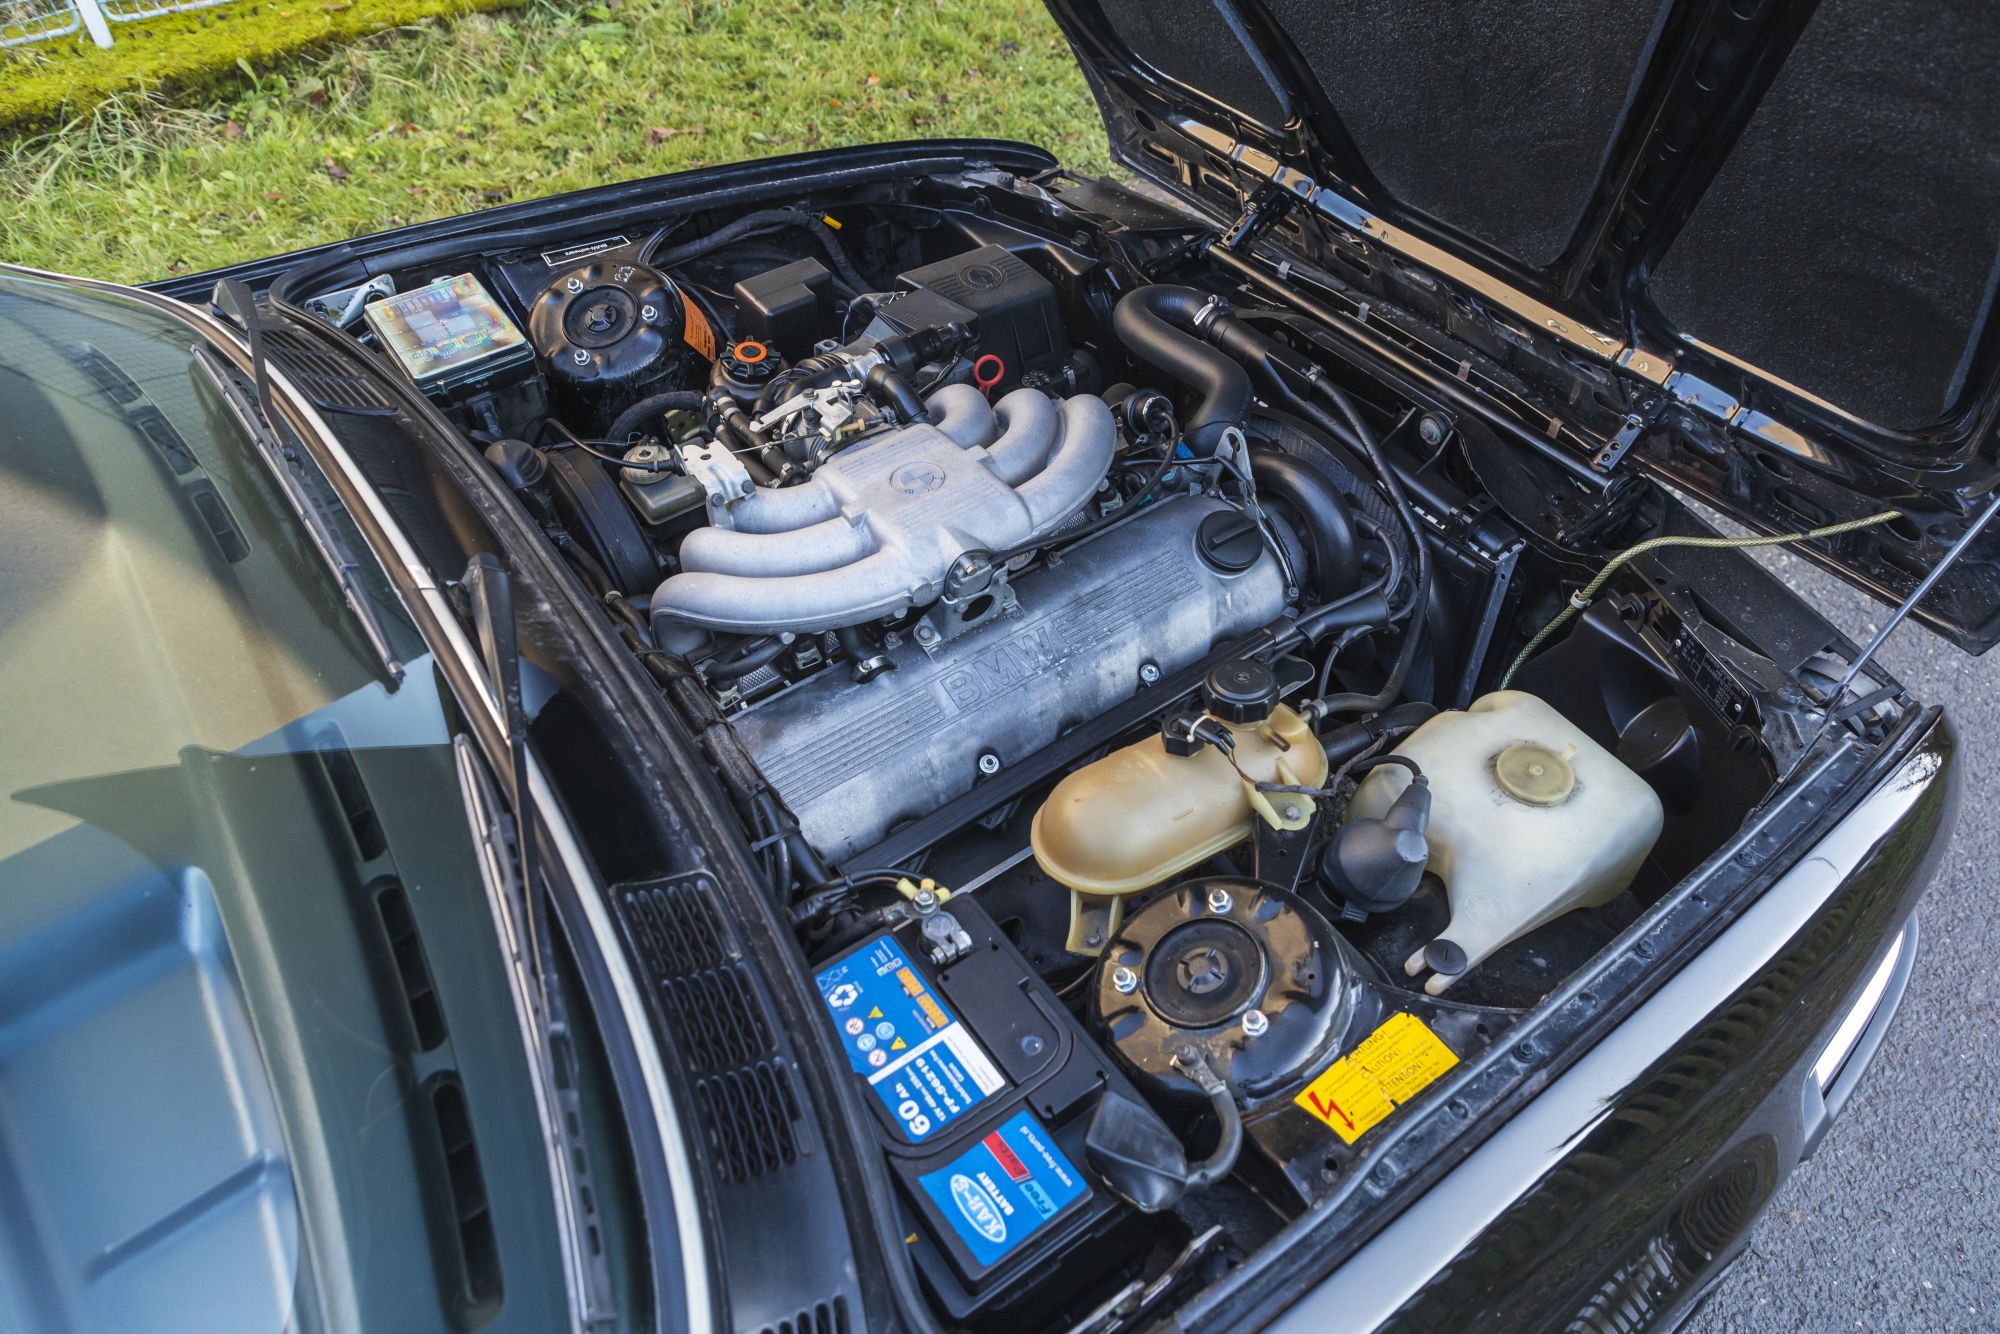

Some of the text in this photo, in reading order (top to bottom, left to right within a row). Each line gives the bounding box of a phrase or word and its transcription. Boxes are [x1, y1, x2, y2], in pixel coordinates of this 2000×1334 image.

[939, 625, 1056, 710] BMW
[895, 1082, 909, 1099] Ah
[898, 1098, 931, 1136] 60
[997, 1141, 1052, 1216] Free Parts
[1019, 1125, 1073, 1187] www.free-parts.nl
[954, 1180, 1001, 1234] KAR-S
[976, 1171, 1015, 1216] BATTERY
